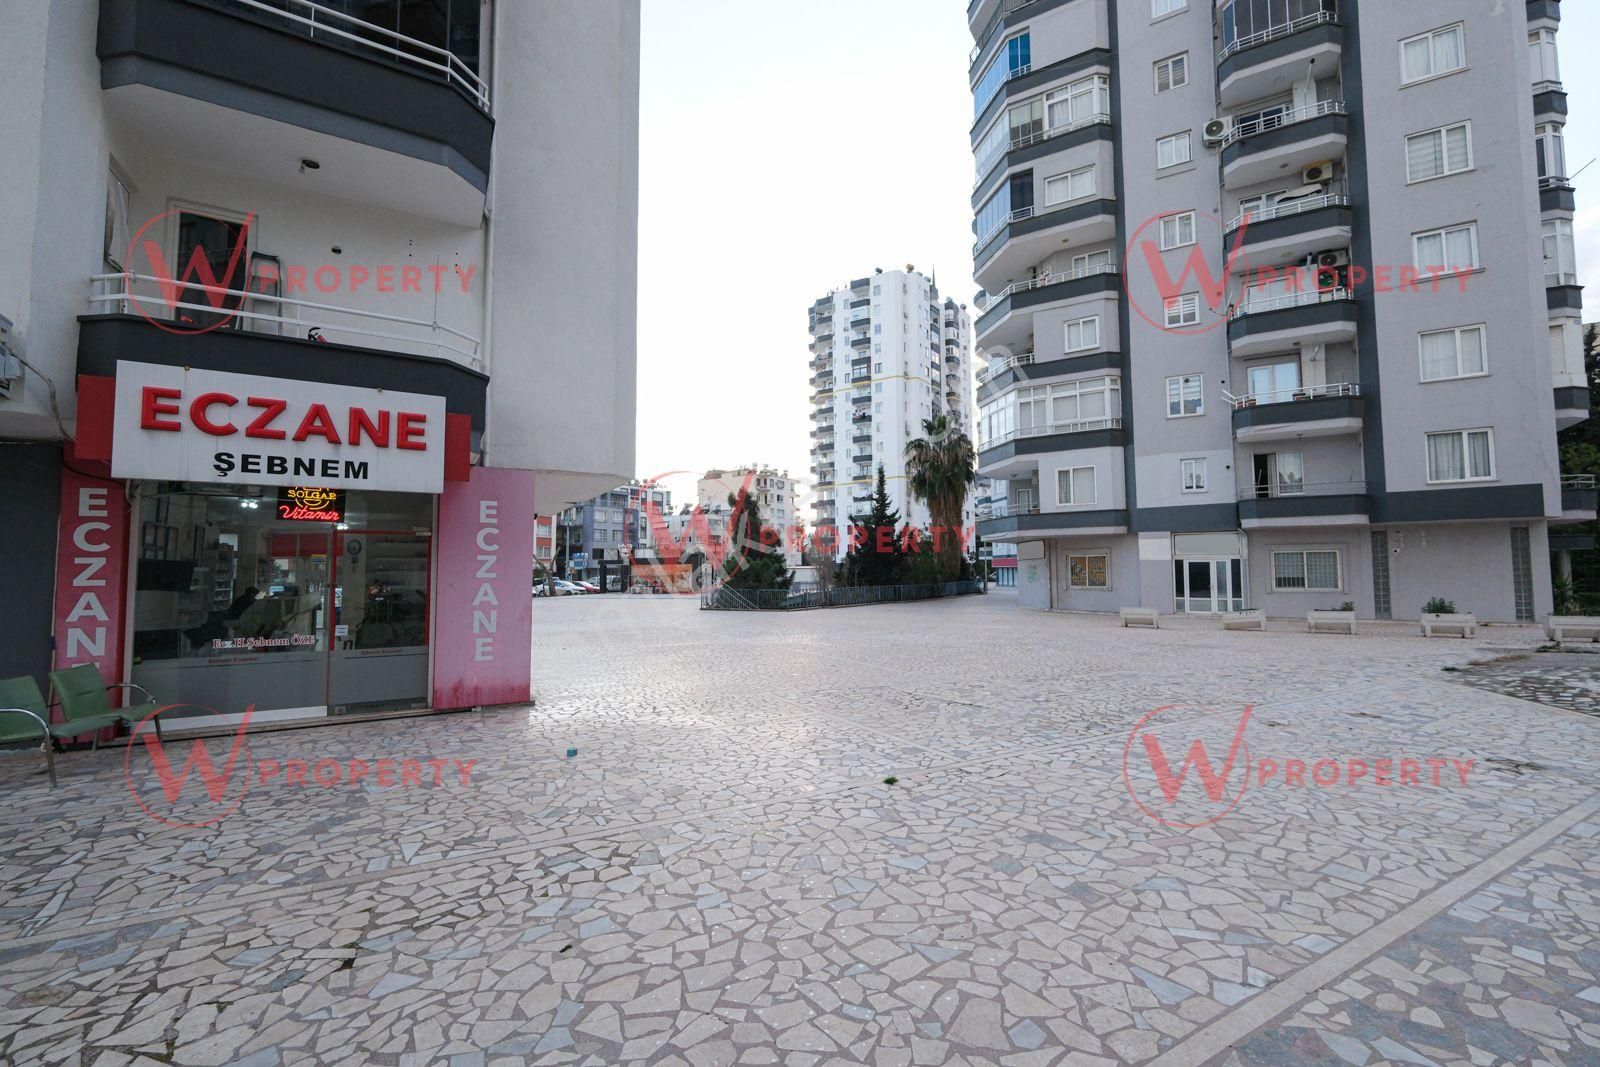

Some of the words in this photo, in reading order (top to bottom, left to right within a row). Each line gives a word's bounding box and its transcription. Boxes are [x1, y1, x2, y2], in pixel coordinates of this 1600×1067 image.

[140, 386, 427, 451] ECZANE
[213, 452, 369, 480] ŞEBNEM
[279, 505, 340, 521] Vitamin
[65, 487, 112, 669] ECZAN
[472, 500, 500, 661] ECZANE
